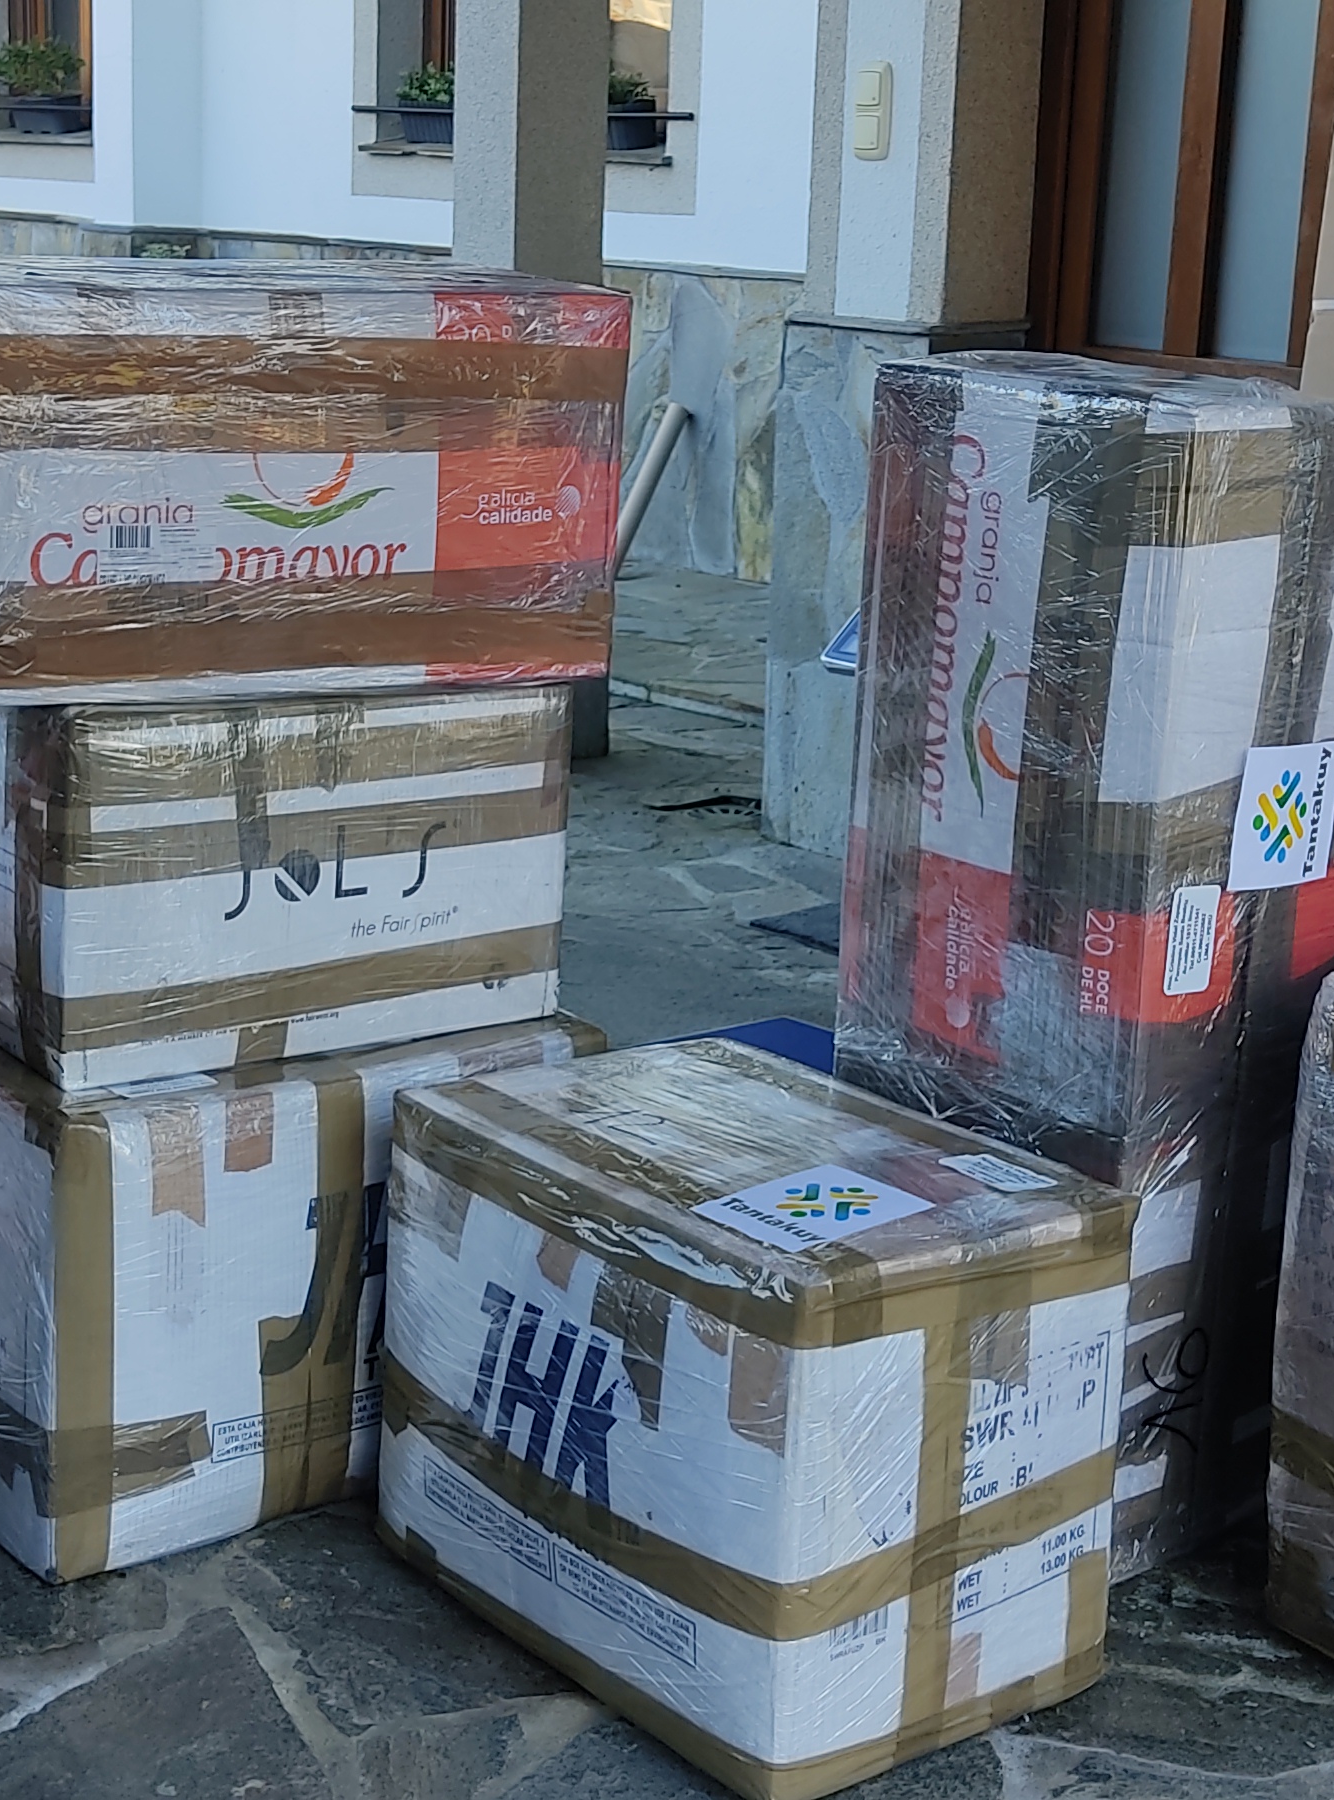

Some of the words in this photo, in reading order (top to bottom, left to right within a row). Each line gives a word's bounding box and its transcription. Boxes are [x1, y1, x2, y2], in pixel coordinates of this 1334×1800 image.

[479, 508, 553, 525] calidade
[1301, 746, 1332, 878] Tantakuy
[350, 918, 377, 938] the
[381, 914, 412, 934] Fair
[1083, 908, 1117, 957] 20
[719, 1196, 827, 1245] Tantakuy
[1040, 1533, 1068, 1556] 11.00
[1040, 1553, 1068, 1576] 13.00
